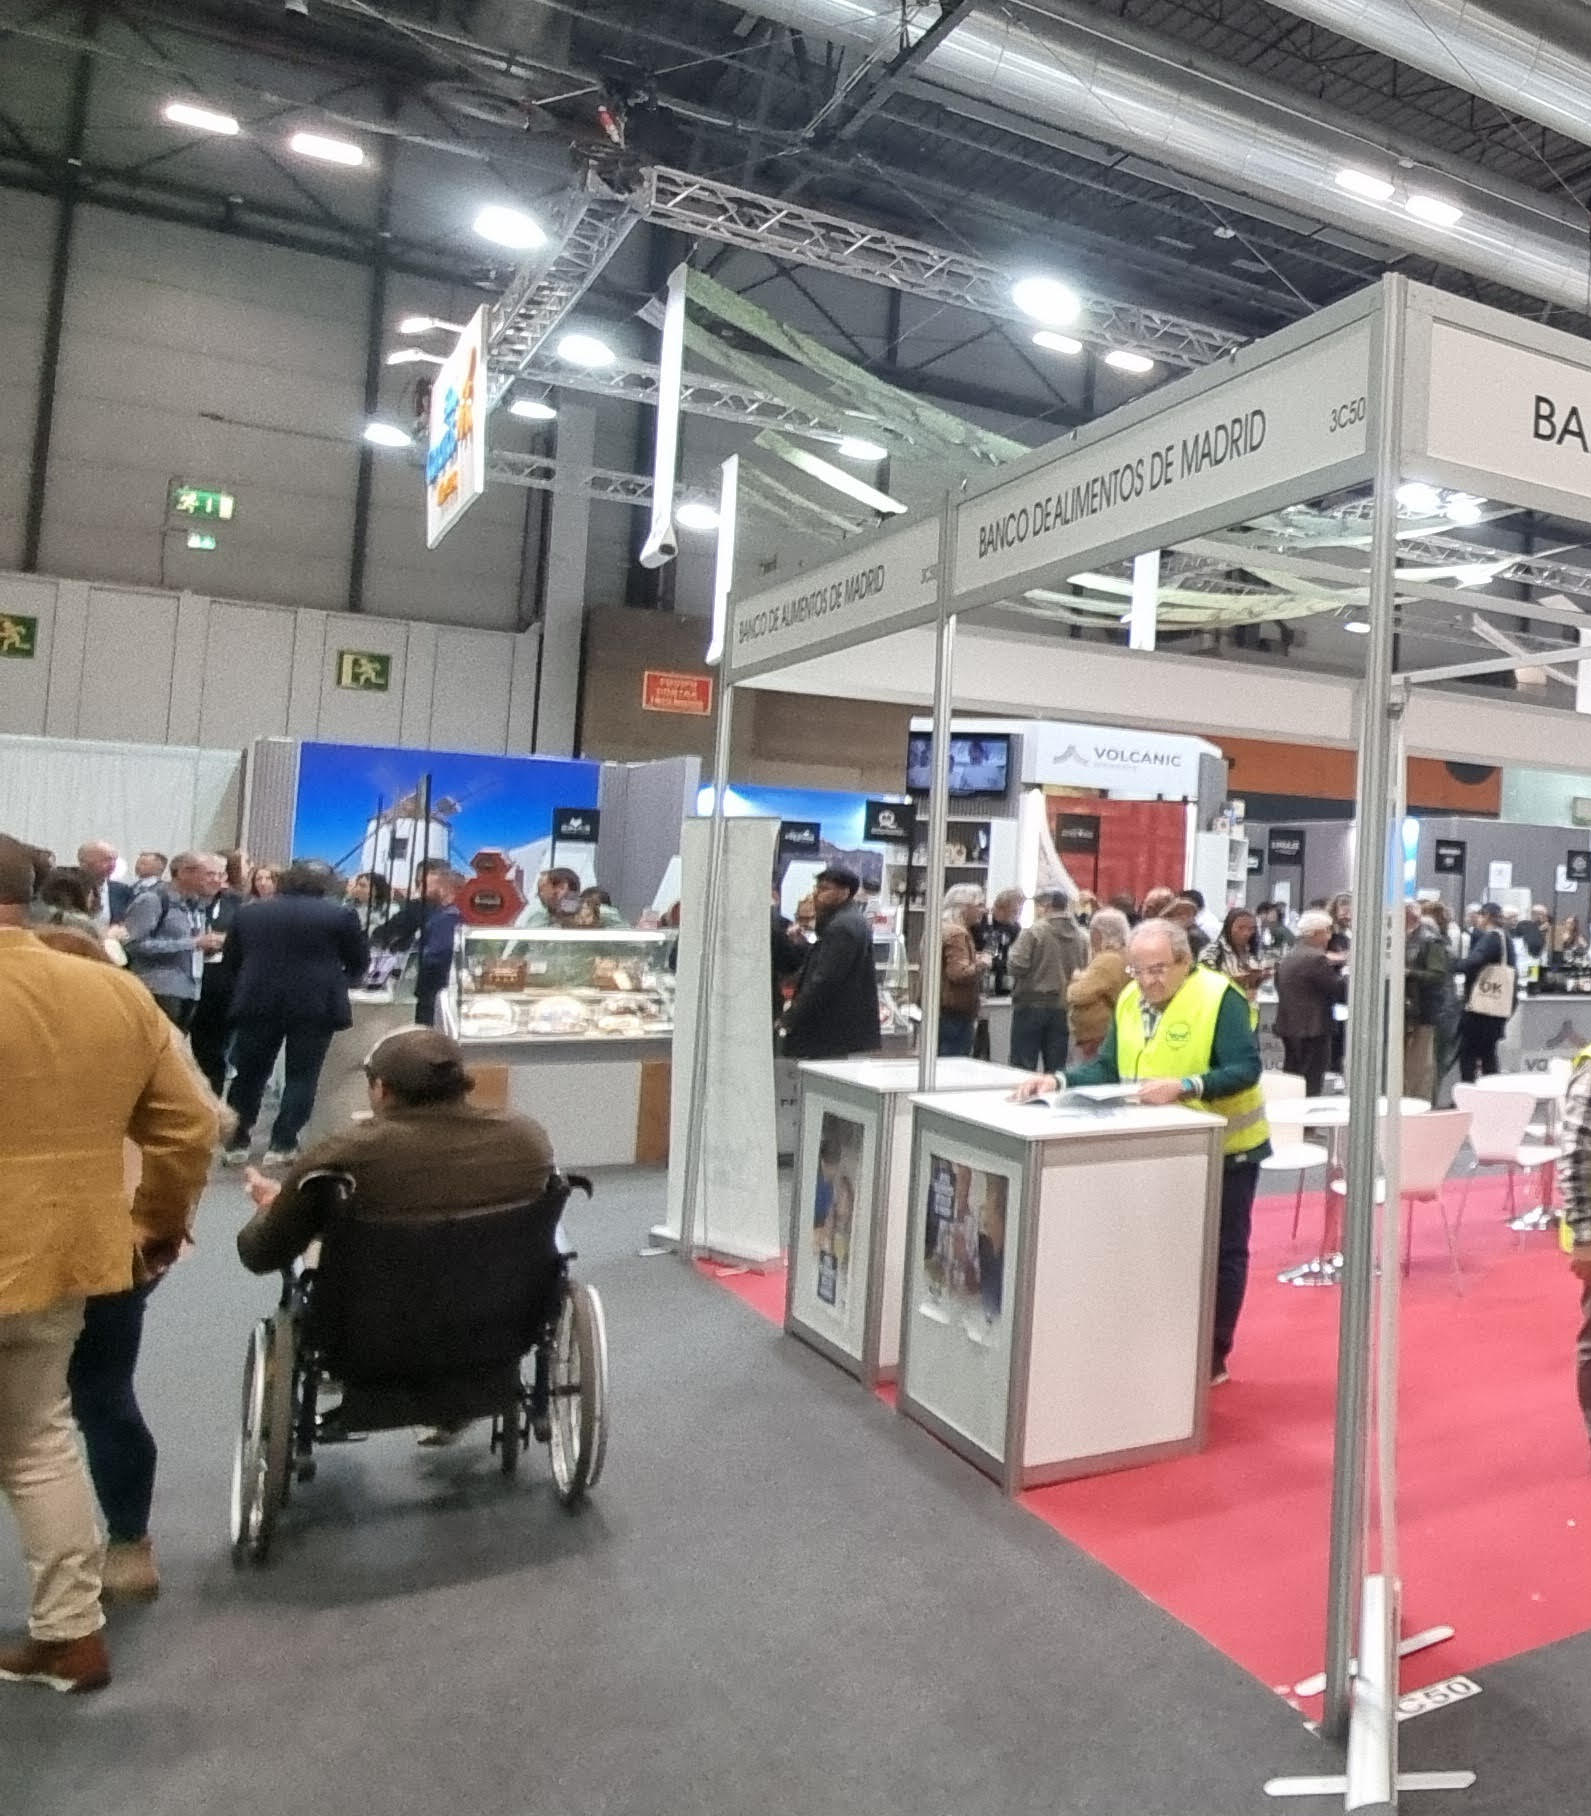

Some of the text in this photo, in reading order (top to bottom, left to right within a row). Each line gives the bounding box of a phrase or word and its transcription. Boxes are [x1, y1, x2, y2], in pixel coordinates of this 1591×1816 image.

[1329, 397, 1366, 433] 3C50
[979, 508, 1029, 559] BANCO
[1149, 444, 1176, 492] DE
[1180, 409, 1266, 480] MADRID
[739, 564, 885, 644] BANCO DE ALIMENTOS DE MADRID
[1094, 747, 1181, 767] VOLCANIC
[1399, 1682, 1471, 1713] C50
